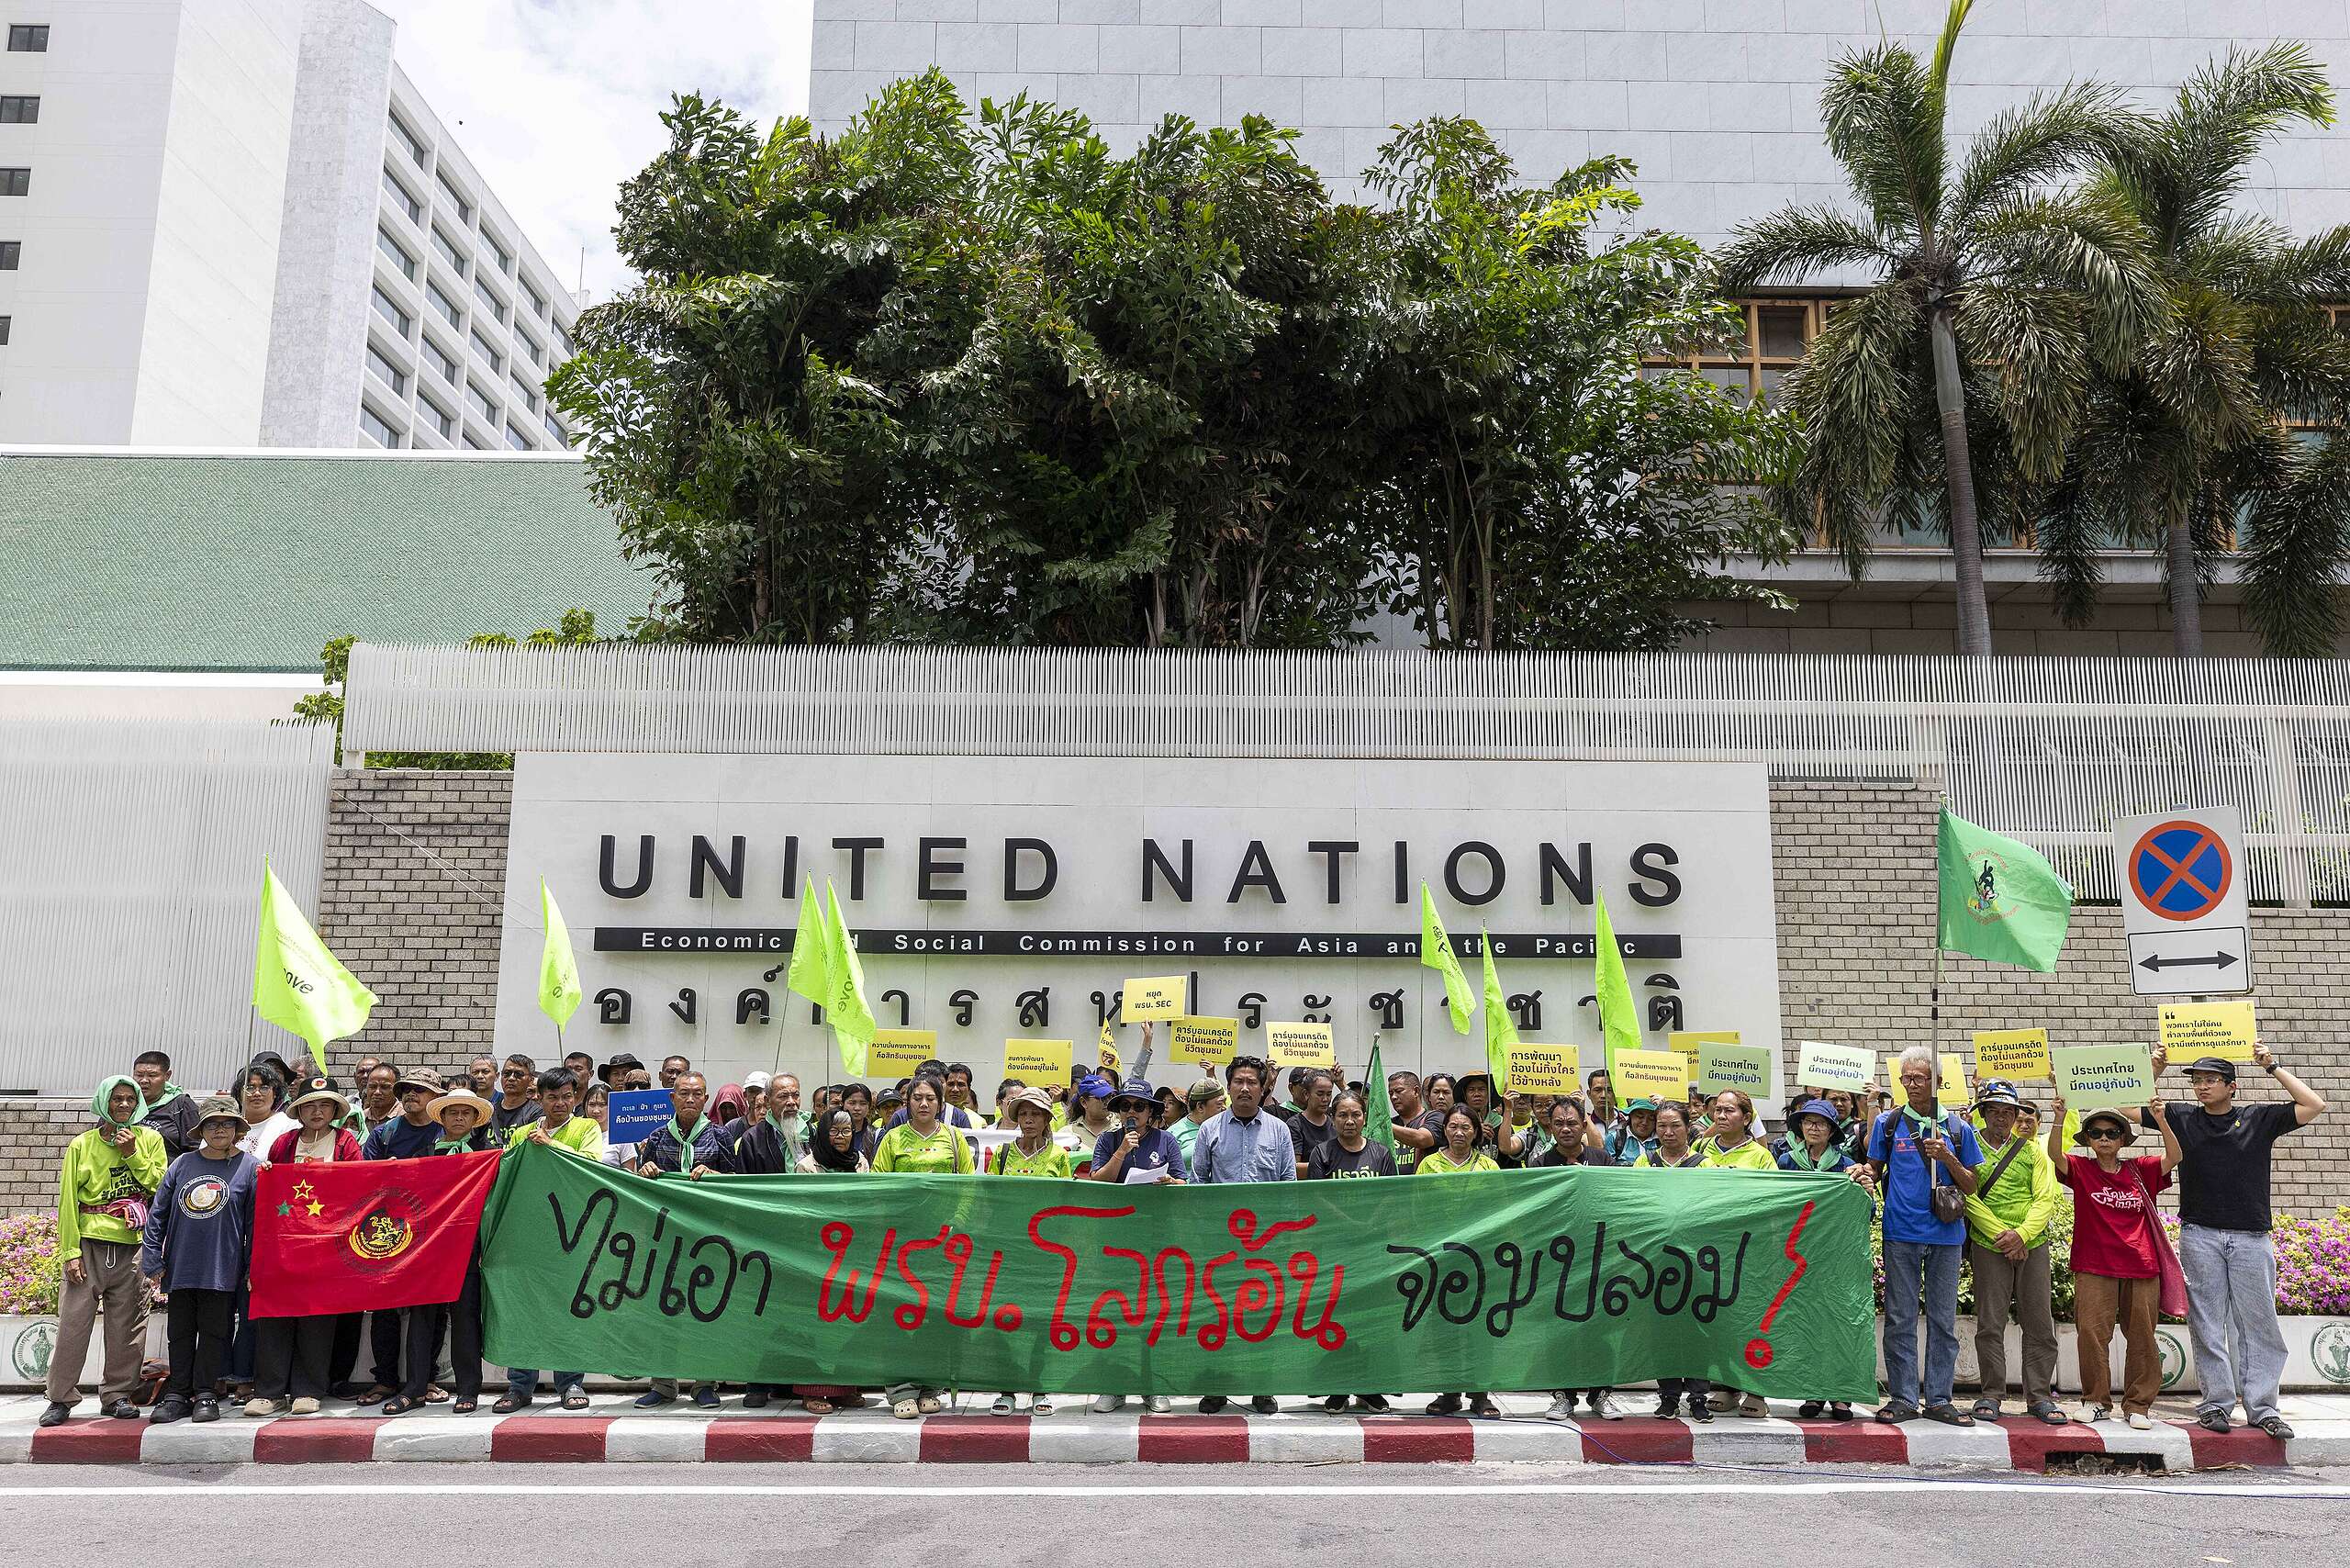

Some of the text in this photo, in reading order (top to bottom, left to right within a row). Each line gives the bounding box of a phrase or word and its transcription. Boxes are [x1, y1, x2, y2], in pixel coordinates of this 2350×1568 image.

[599, 834, 1683, 908] UNITED NATIONS
[641, 932, 782, 950] Economic
[894, 934, 984, 951] Social
[1019, 935, 1195, 953] Commission
[1225, 936, 1263, 953] for
[1297, 936, 1359, 954] Asia
[1387, 941, 1416, 954] an
[1536, 939, 1636, 954] Pacic
[1146, 990, 1161, 999] หยุด
[1156, 1000, 1172, 1008] SEC
[1176, 1025, 1233, 1037] คาร์บอนเครดิต
[2165, 1020, 2222, 1029] พวกเราไม่ใช่คน
[1175, 1035, 1233, 1047] ต้องไม่แลกด้วย
[1272, 1031, 1327, 1041] คาร์บอนเครดิต
[1272, 1039, 1329, 1049] ต้องไม่แลกด้วย
[1980, 1039, 2042, 1053] คาร์บอนเครดิต
[2167, 1037, 2246, 1049] เรามีแต่การดูแลรักษา
[1185, 1045, 1222, 1055] ชีวิตชุมชน
[1283, 1048, 1320, 1058] ชีวิตชุมชน
[1511, 1049, 1561, 1062] การพัฒนา
[1980, 1049, 2044, 1063] ต้องไม่แลกด้วย
[1511, 1061, 1575, 1075] ต้องไม่ทิ้งใคร
[1711, 1058, 1759, 1070] ประเทศไทย
[1812, 1055, 1862, 1069] ประเทศไทย
[1992, 1059, 2034, 1071] ชีวิตชุมชน
[2071, 1061, 2135, 1076] ประเทศไทย
[1707, 1070, 1762, 1084] มีคนอยู่กับป่า
[1808, 1064, 1864, 1080] มีคนอยู่กับป่า
[1511, 1074, 1561, 1087] ไว้ข้างหลัง
[2070, 1077, 2142, 1093] มีคนอยู่กับป่า
[548, 1187, 772, 1324] ไม่เอา
